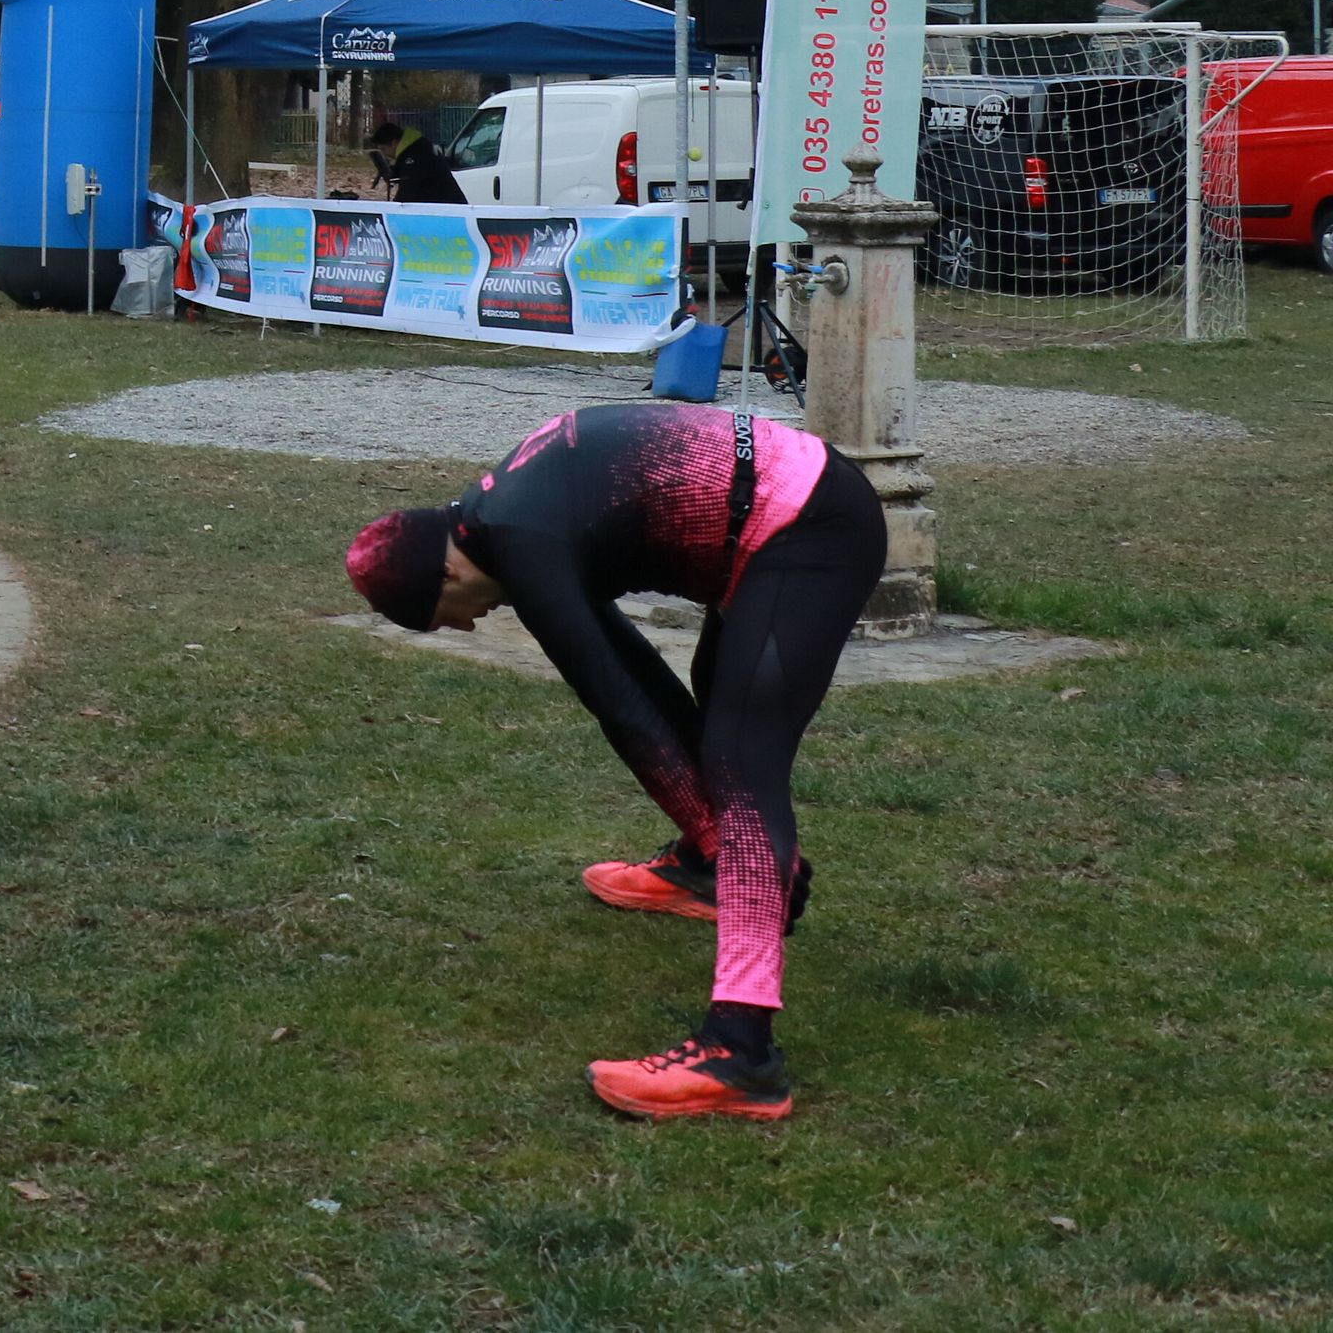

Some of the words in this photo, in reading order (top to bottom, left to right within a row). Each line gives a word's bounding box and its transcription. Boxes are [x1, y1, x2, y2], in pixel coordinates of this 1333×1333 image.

[332, 33, 385, 51] Carvico
[332, 51, 396, 62] SKYRUNNING
[808, 32, 837, 108] 4380
[976, 115, 1004, 125] SPORT
[802, 117, 831, 173] 035
[316, 224, 350, 258] SKY
[356, 235, 384, 258] CANTO
[485, 233, 531, 269] SKY
[315, 265, 386, 284] RUNNING
[482, 277, 563, 296] RUNNING
[313, 293, 344, 304] PERCORSO
[481, 309, 520, 320] PERCORSO
